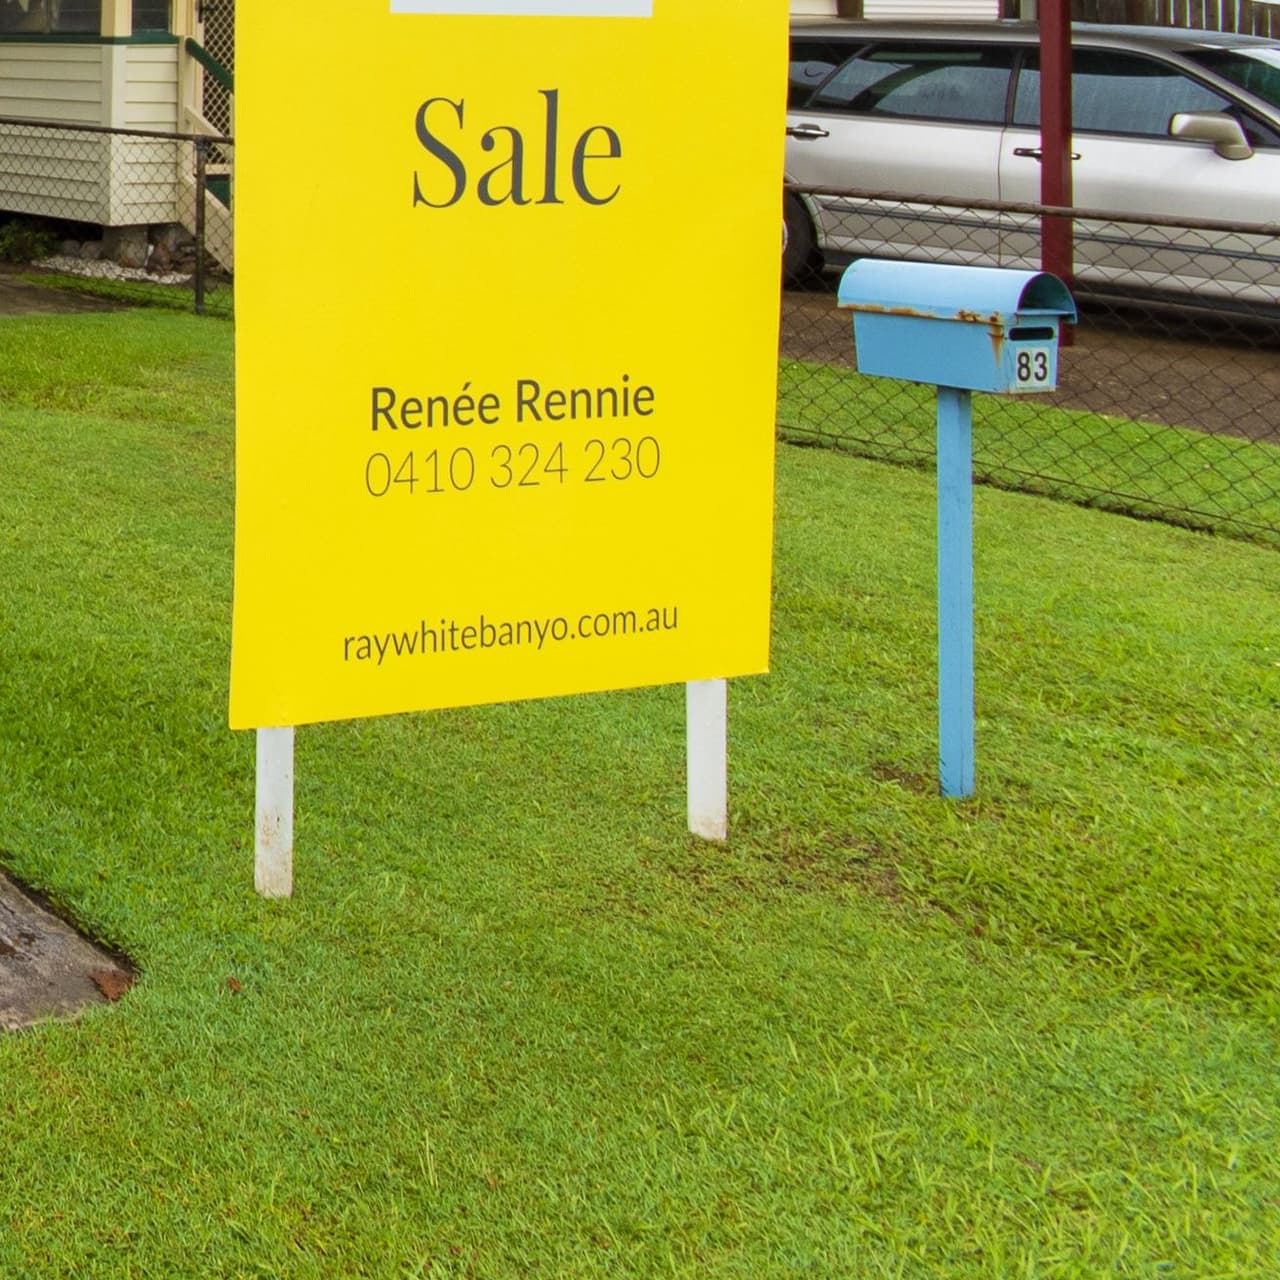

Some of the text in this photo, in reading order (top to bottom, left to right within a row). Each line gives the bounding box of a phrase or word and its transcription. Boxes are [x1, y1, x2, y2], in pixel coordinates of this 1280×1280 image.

[412, 87, 623, 209] Sale
[1017, 351, 1048, 382] 83
[371, 373, 655, 432] Renée Rennie
[365, 436, 661, 497] 0410 324 230
[343, 605, 678, 666] raywhitebanyo.com.au
